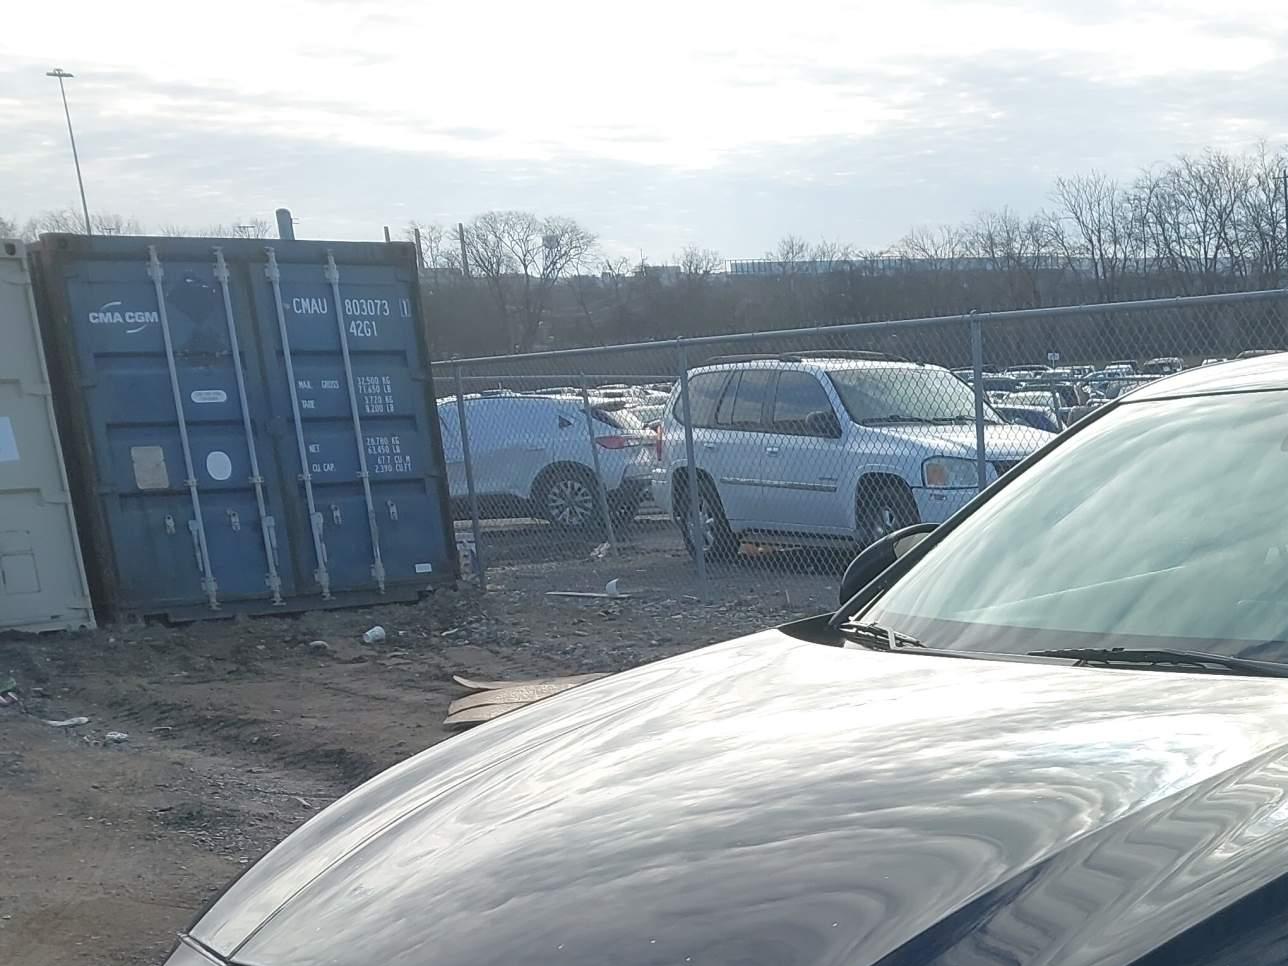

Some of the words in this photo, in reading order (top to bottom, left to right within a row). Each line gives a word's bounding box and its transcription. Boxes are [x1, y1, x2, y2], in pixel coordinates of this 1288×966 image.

[292, 298, 328, 314] CMAU
[344, 299, 390, 316] 803073
[88, 311, 125, 324] CMA
[125, 311, 159, 323] CGM
[349, 320, 378, 337] 42G1
